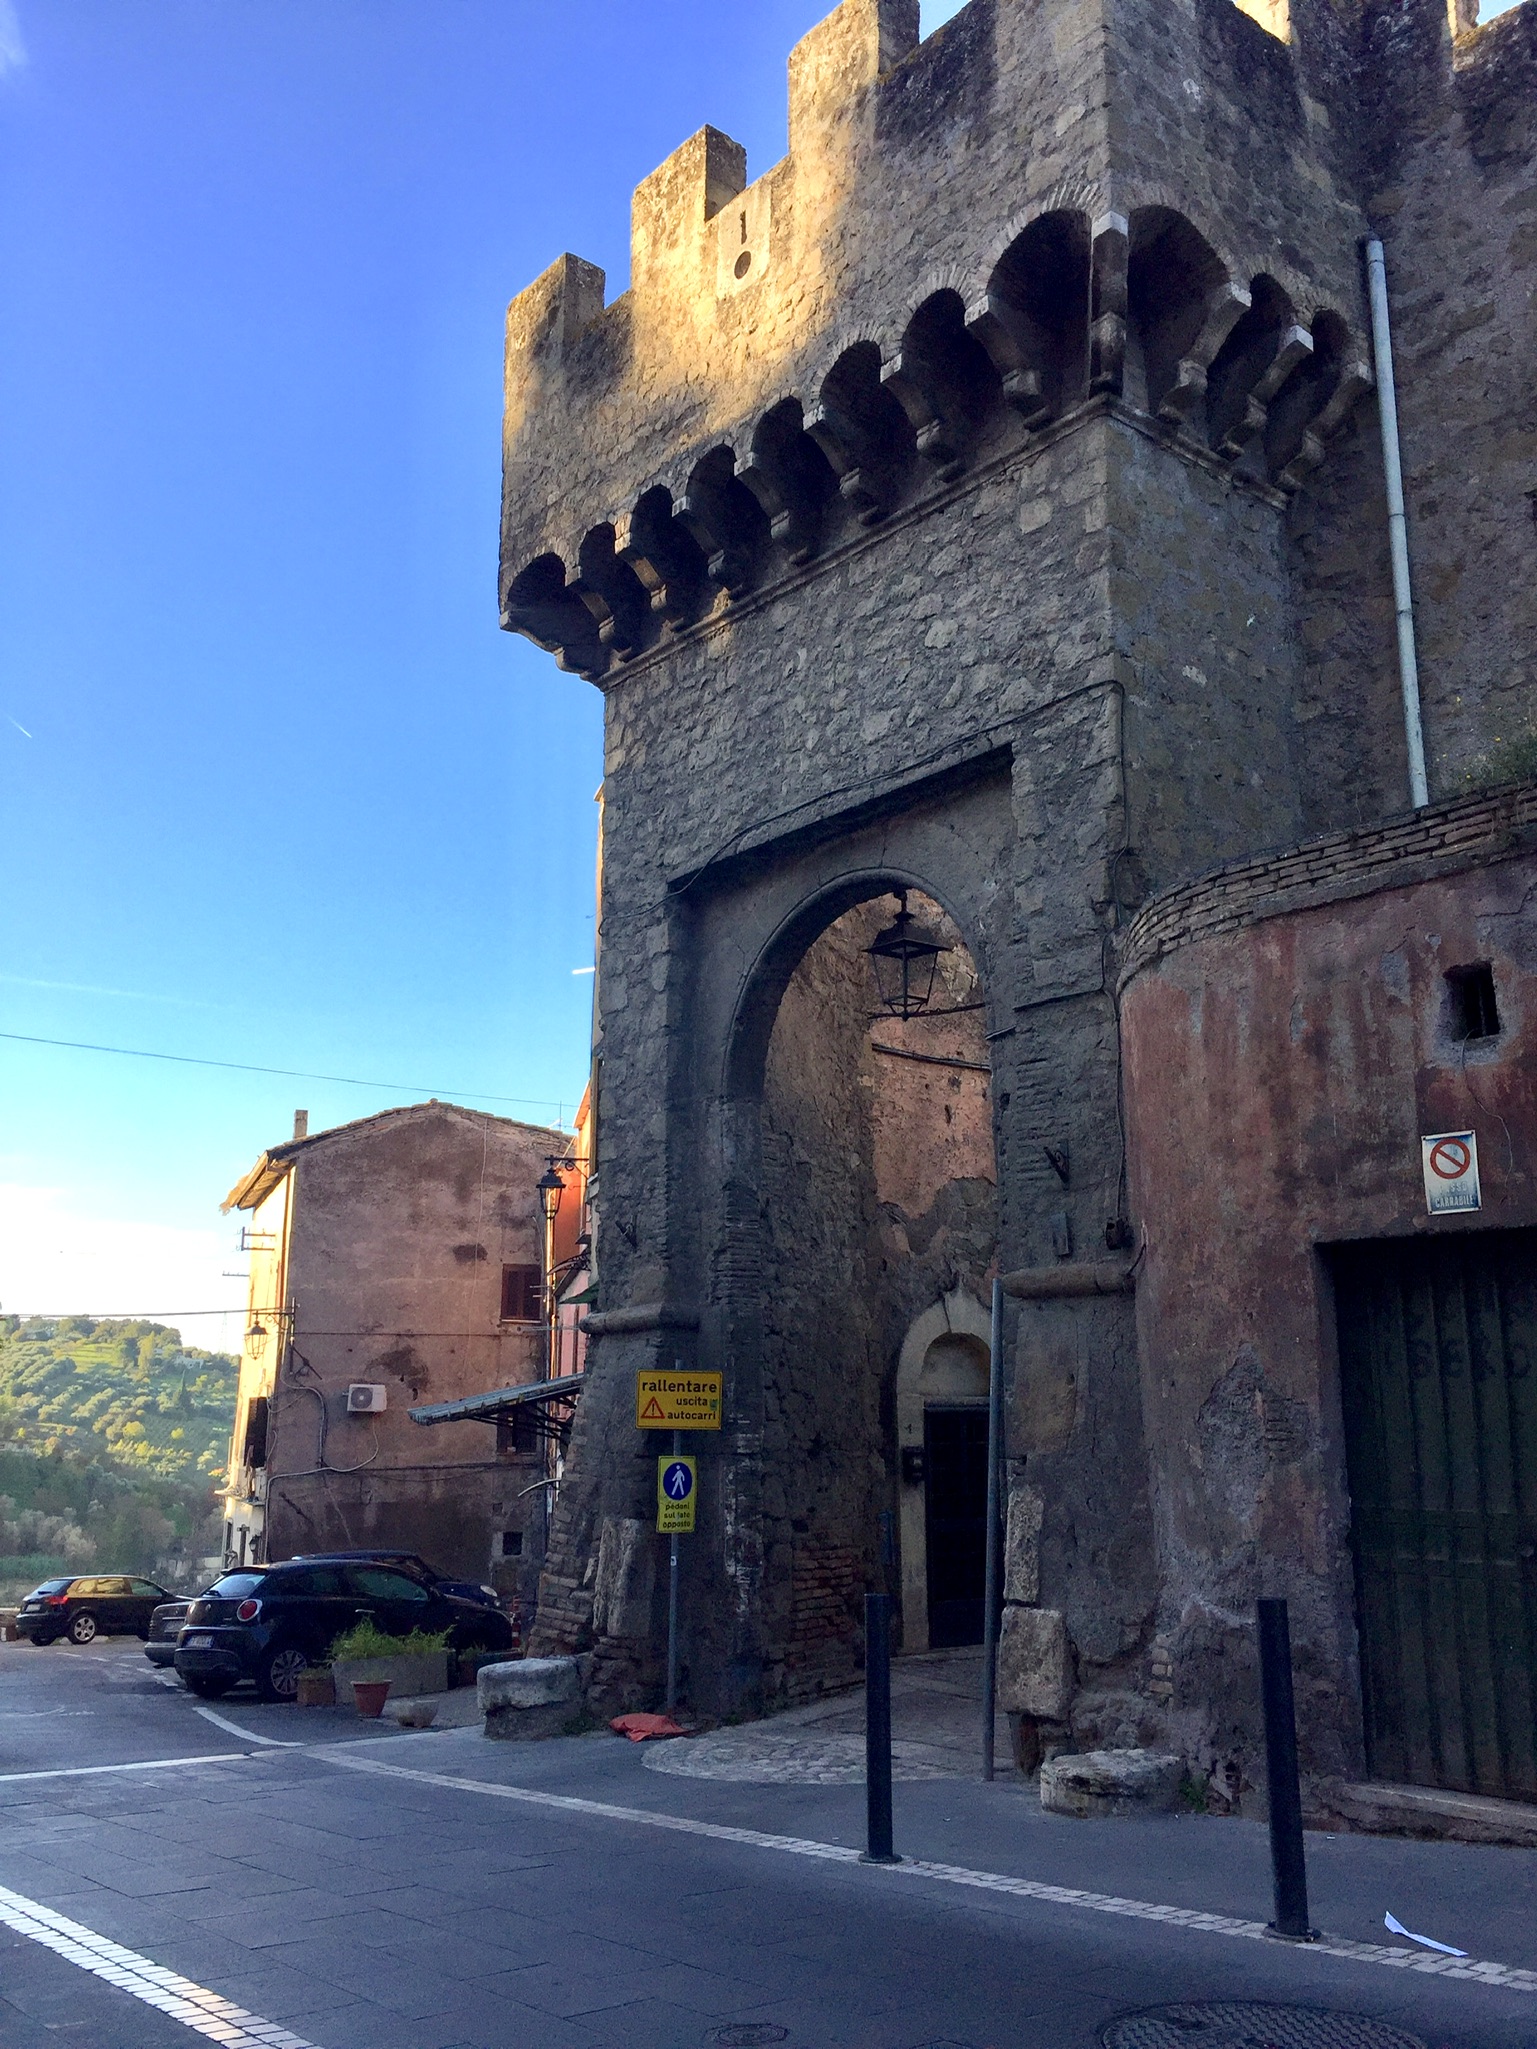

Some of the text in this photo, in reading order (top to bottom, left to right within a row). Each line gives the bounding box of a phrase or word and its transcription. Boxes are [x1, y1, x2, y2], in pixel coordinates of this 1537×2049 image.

[1435, 1195, 1474, 1208] CARRABILE
[642, 1379, 717, 1393] rallentare
[676, 1396, 708, 1406] uscita
[667, 1410, 716, 1420] autocarri
[665, 1502, 690, 1512] pedoni
[663, 1511, 675, 1519] sul
[662, 1520, 691, 1529] opposto
